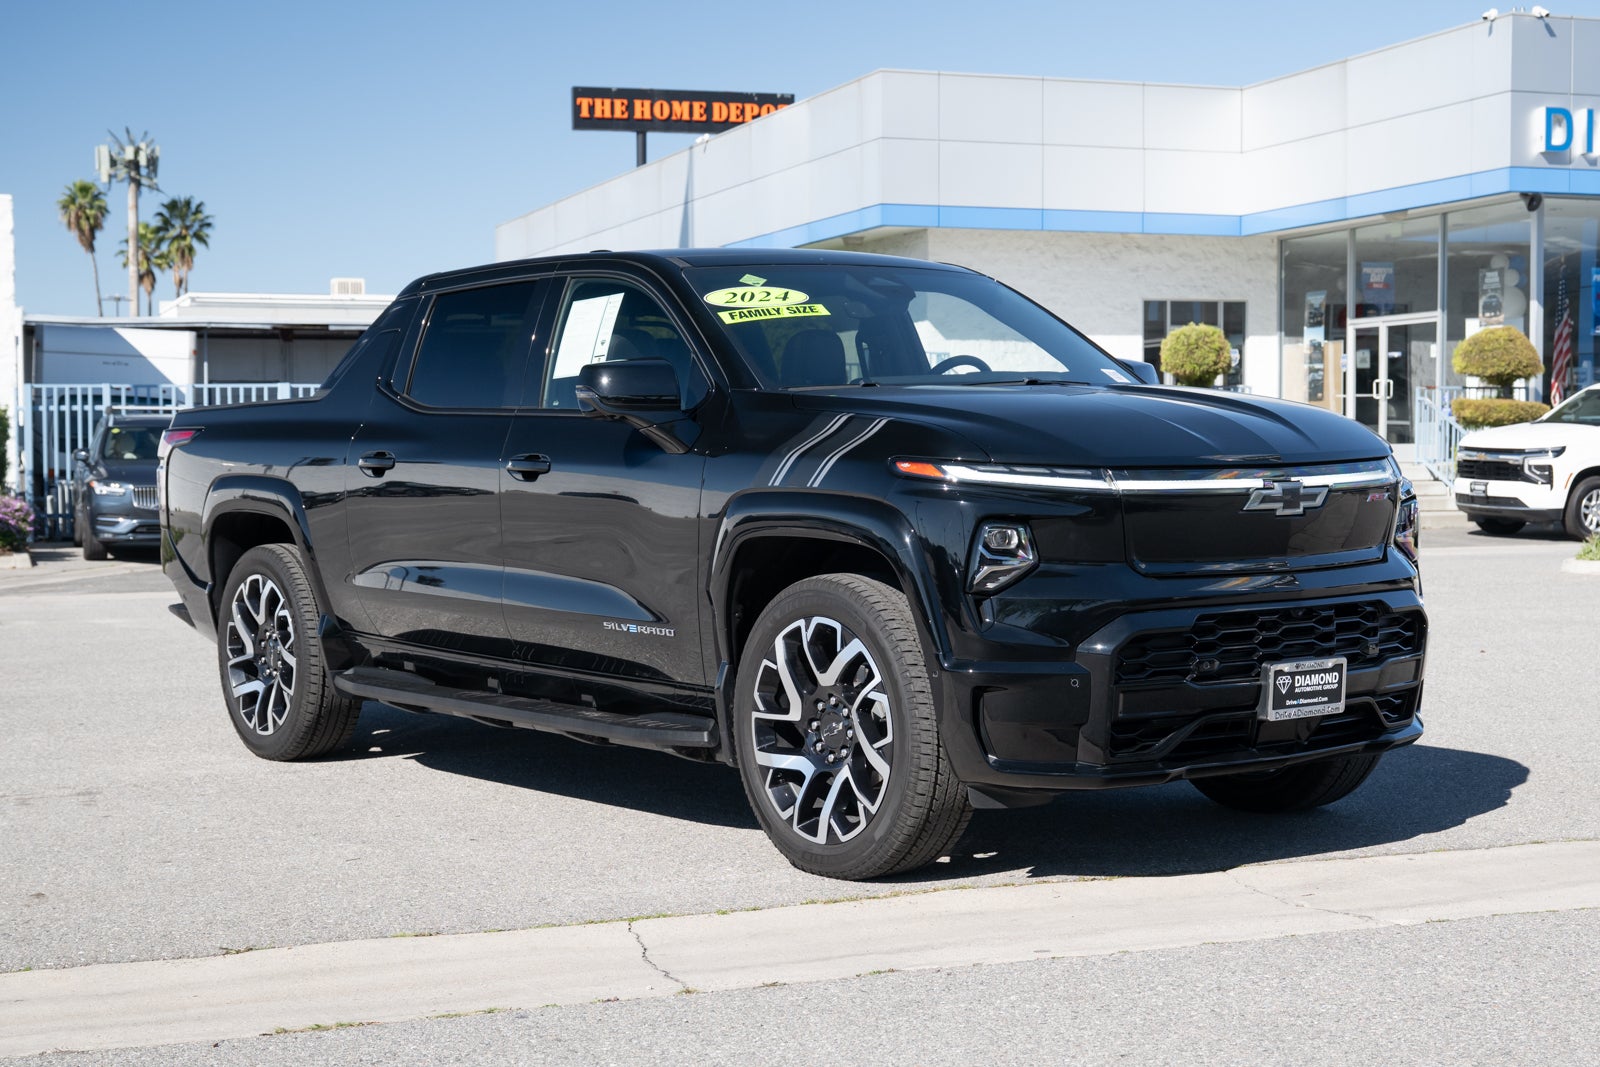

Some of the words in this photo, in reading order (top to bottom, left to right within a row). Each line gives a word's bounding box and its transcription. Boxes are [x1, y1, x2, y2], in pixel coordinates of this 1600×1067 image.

[576, 97, 629, 119] THE
[633, 99, 707, 122] HOME
[1545, 106, 1594, 154] DI
[724, 290, 790, 304] 2024
[728, 307, 780, 320] FAMILY
[786, 305, 818, 314] SIZE
[603, 621, 675, 636] SILVERADO
[1294, 672, 1339, 687] DIAMOND
